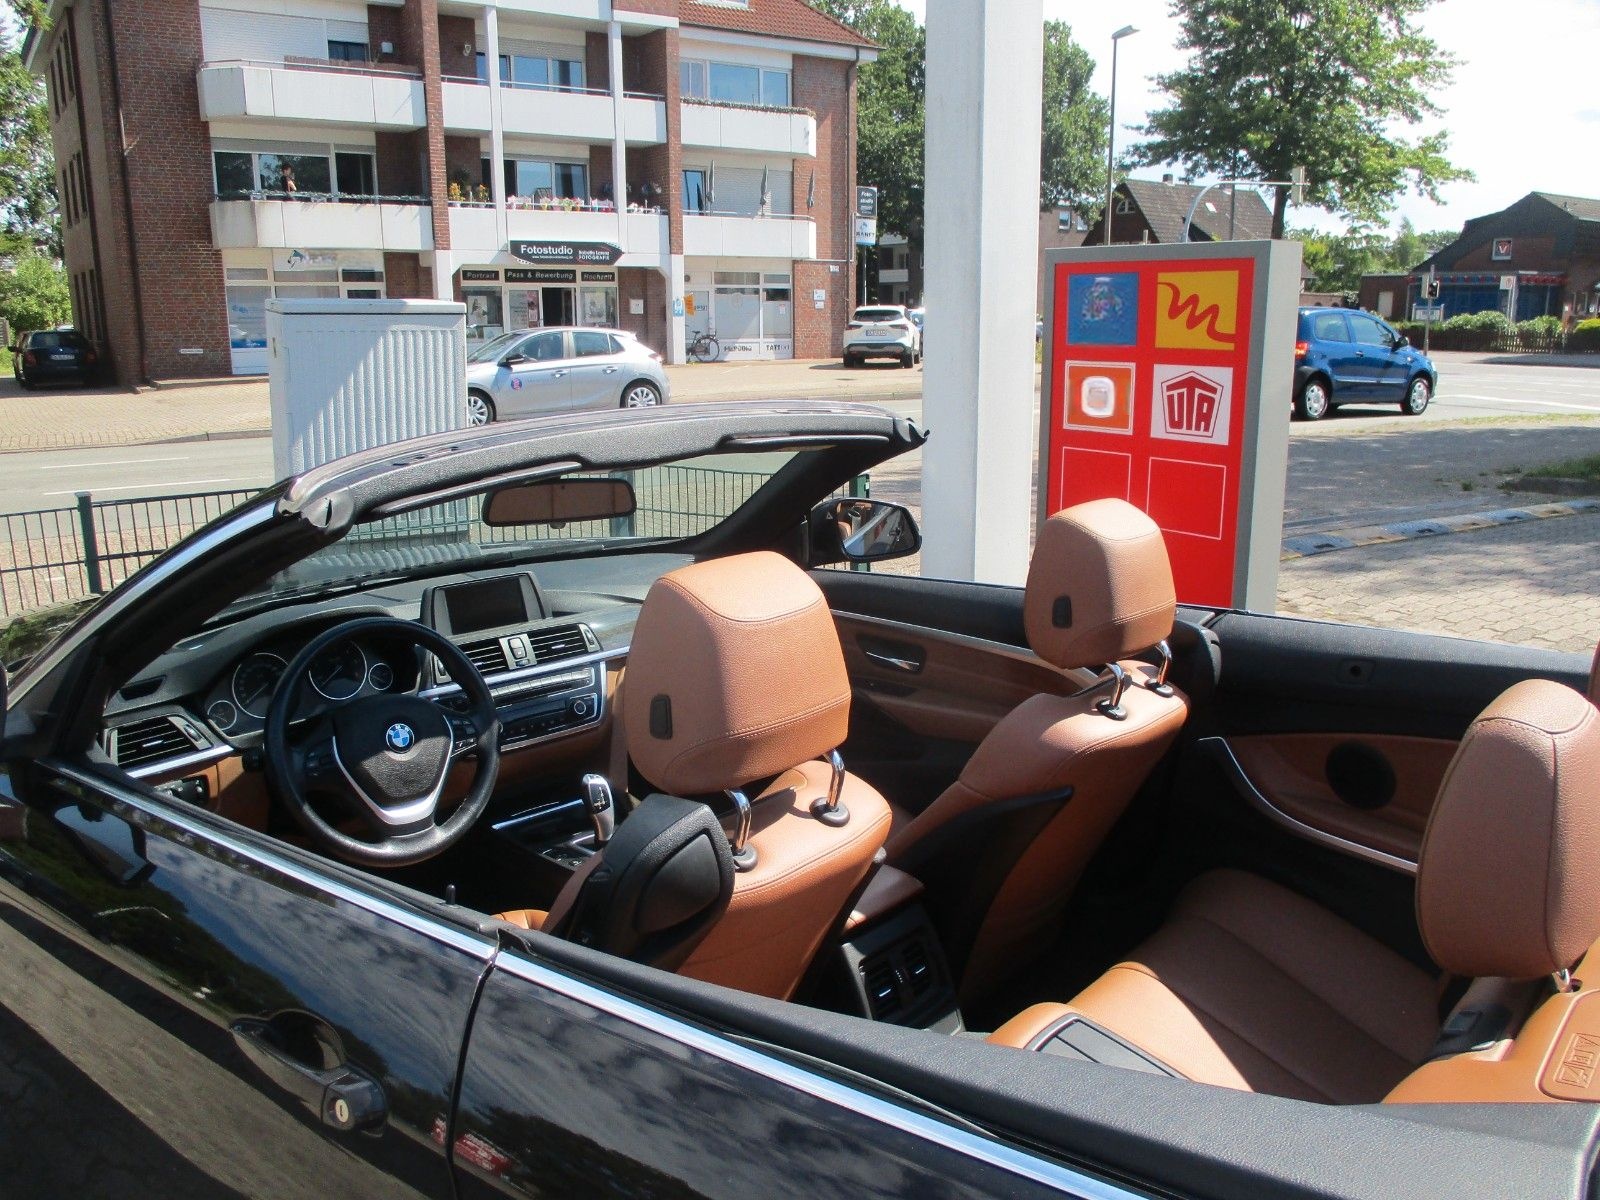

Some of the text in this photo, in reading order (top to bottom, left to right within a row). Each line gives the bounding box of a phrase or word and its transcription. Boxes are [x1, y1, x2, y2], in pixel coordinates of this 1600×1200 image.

[520, 244, 574, 255] Fotostudio
[535, 271, 574, 280] Bewerbung
[1165, 375, 1218, 433] UTA
